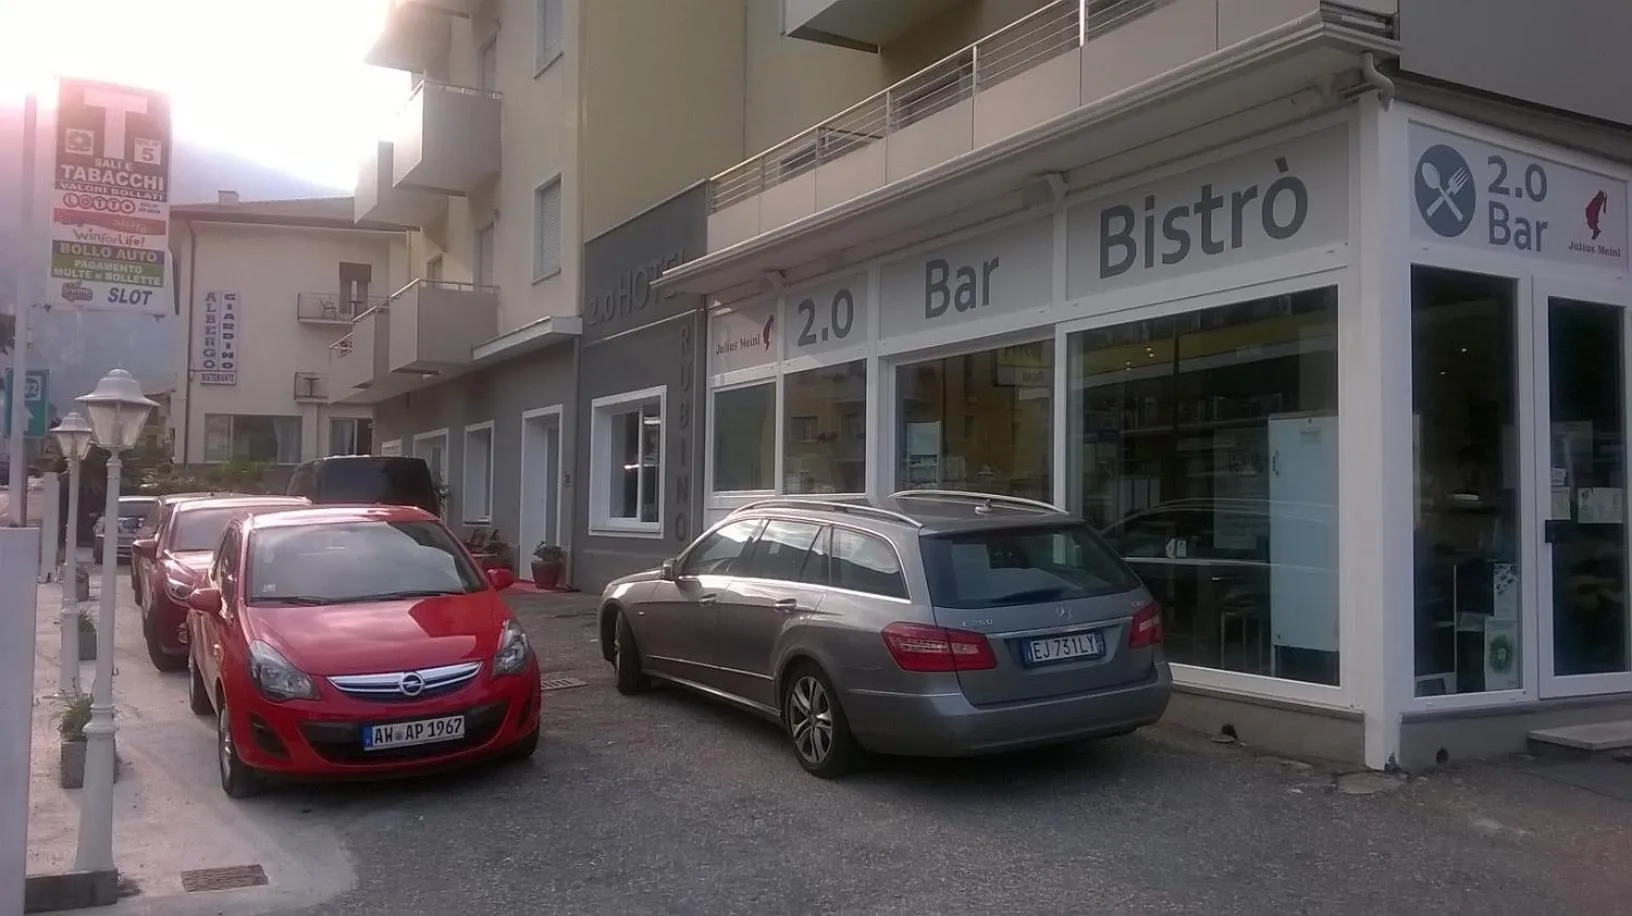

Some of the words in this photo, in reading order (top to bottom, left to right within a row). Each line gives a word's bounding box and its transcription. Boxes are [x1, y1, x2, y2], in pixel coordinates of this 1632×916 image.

[83, 88, 148, 160] T
[95, 158, 121, 169] SALI
[124, 161, 134, 171] E
[142, 147, 154, 162] 5
[60, 164, 164, 191] TABACCHI
[60, 181, 108, 195] VALORI
[111, 187, 164, 201] BOLLATI
[1487, 155, 1548, 202] 2.0
[63, 192, 135, 215] LOTTO
[1099, 156, 1309, 280] Bistrò
[1488, 200, 1548, 252] Bar
[60, 241, 112, 258] BOLLO
[116, 248, 157, 263] AUTO
[53, 267, 93, 280] MULTE
[105, 272, 161, 286] BOLLETTE
[75, 259, 142, 274] PAGAMENTO
[107, 286, 153, 305] SLOT
[925, 257, 1000, 320] Bar
[203, 292, 217, 369] ALBERGO
[222, 293, 237, 369] GIARDINO
[797, 288, 855, 347] 2.0
[1033, 639, 1051, 660] EJ
[1054, 632, 1095, 657] 731LY
[405, 723, 424, 740] AP
[428, 717, 463, 738] 1967
